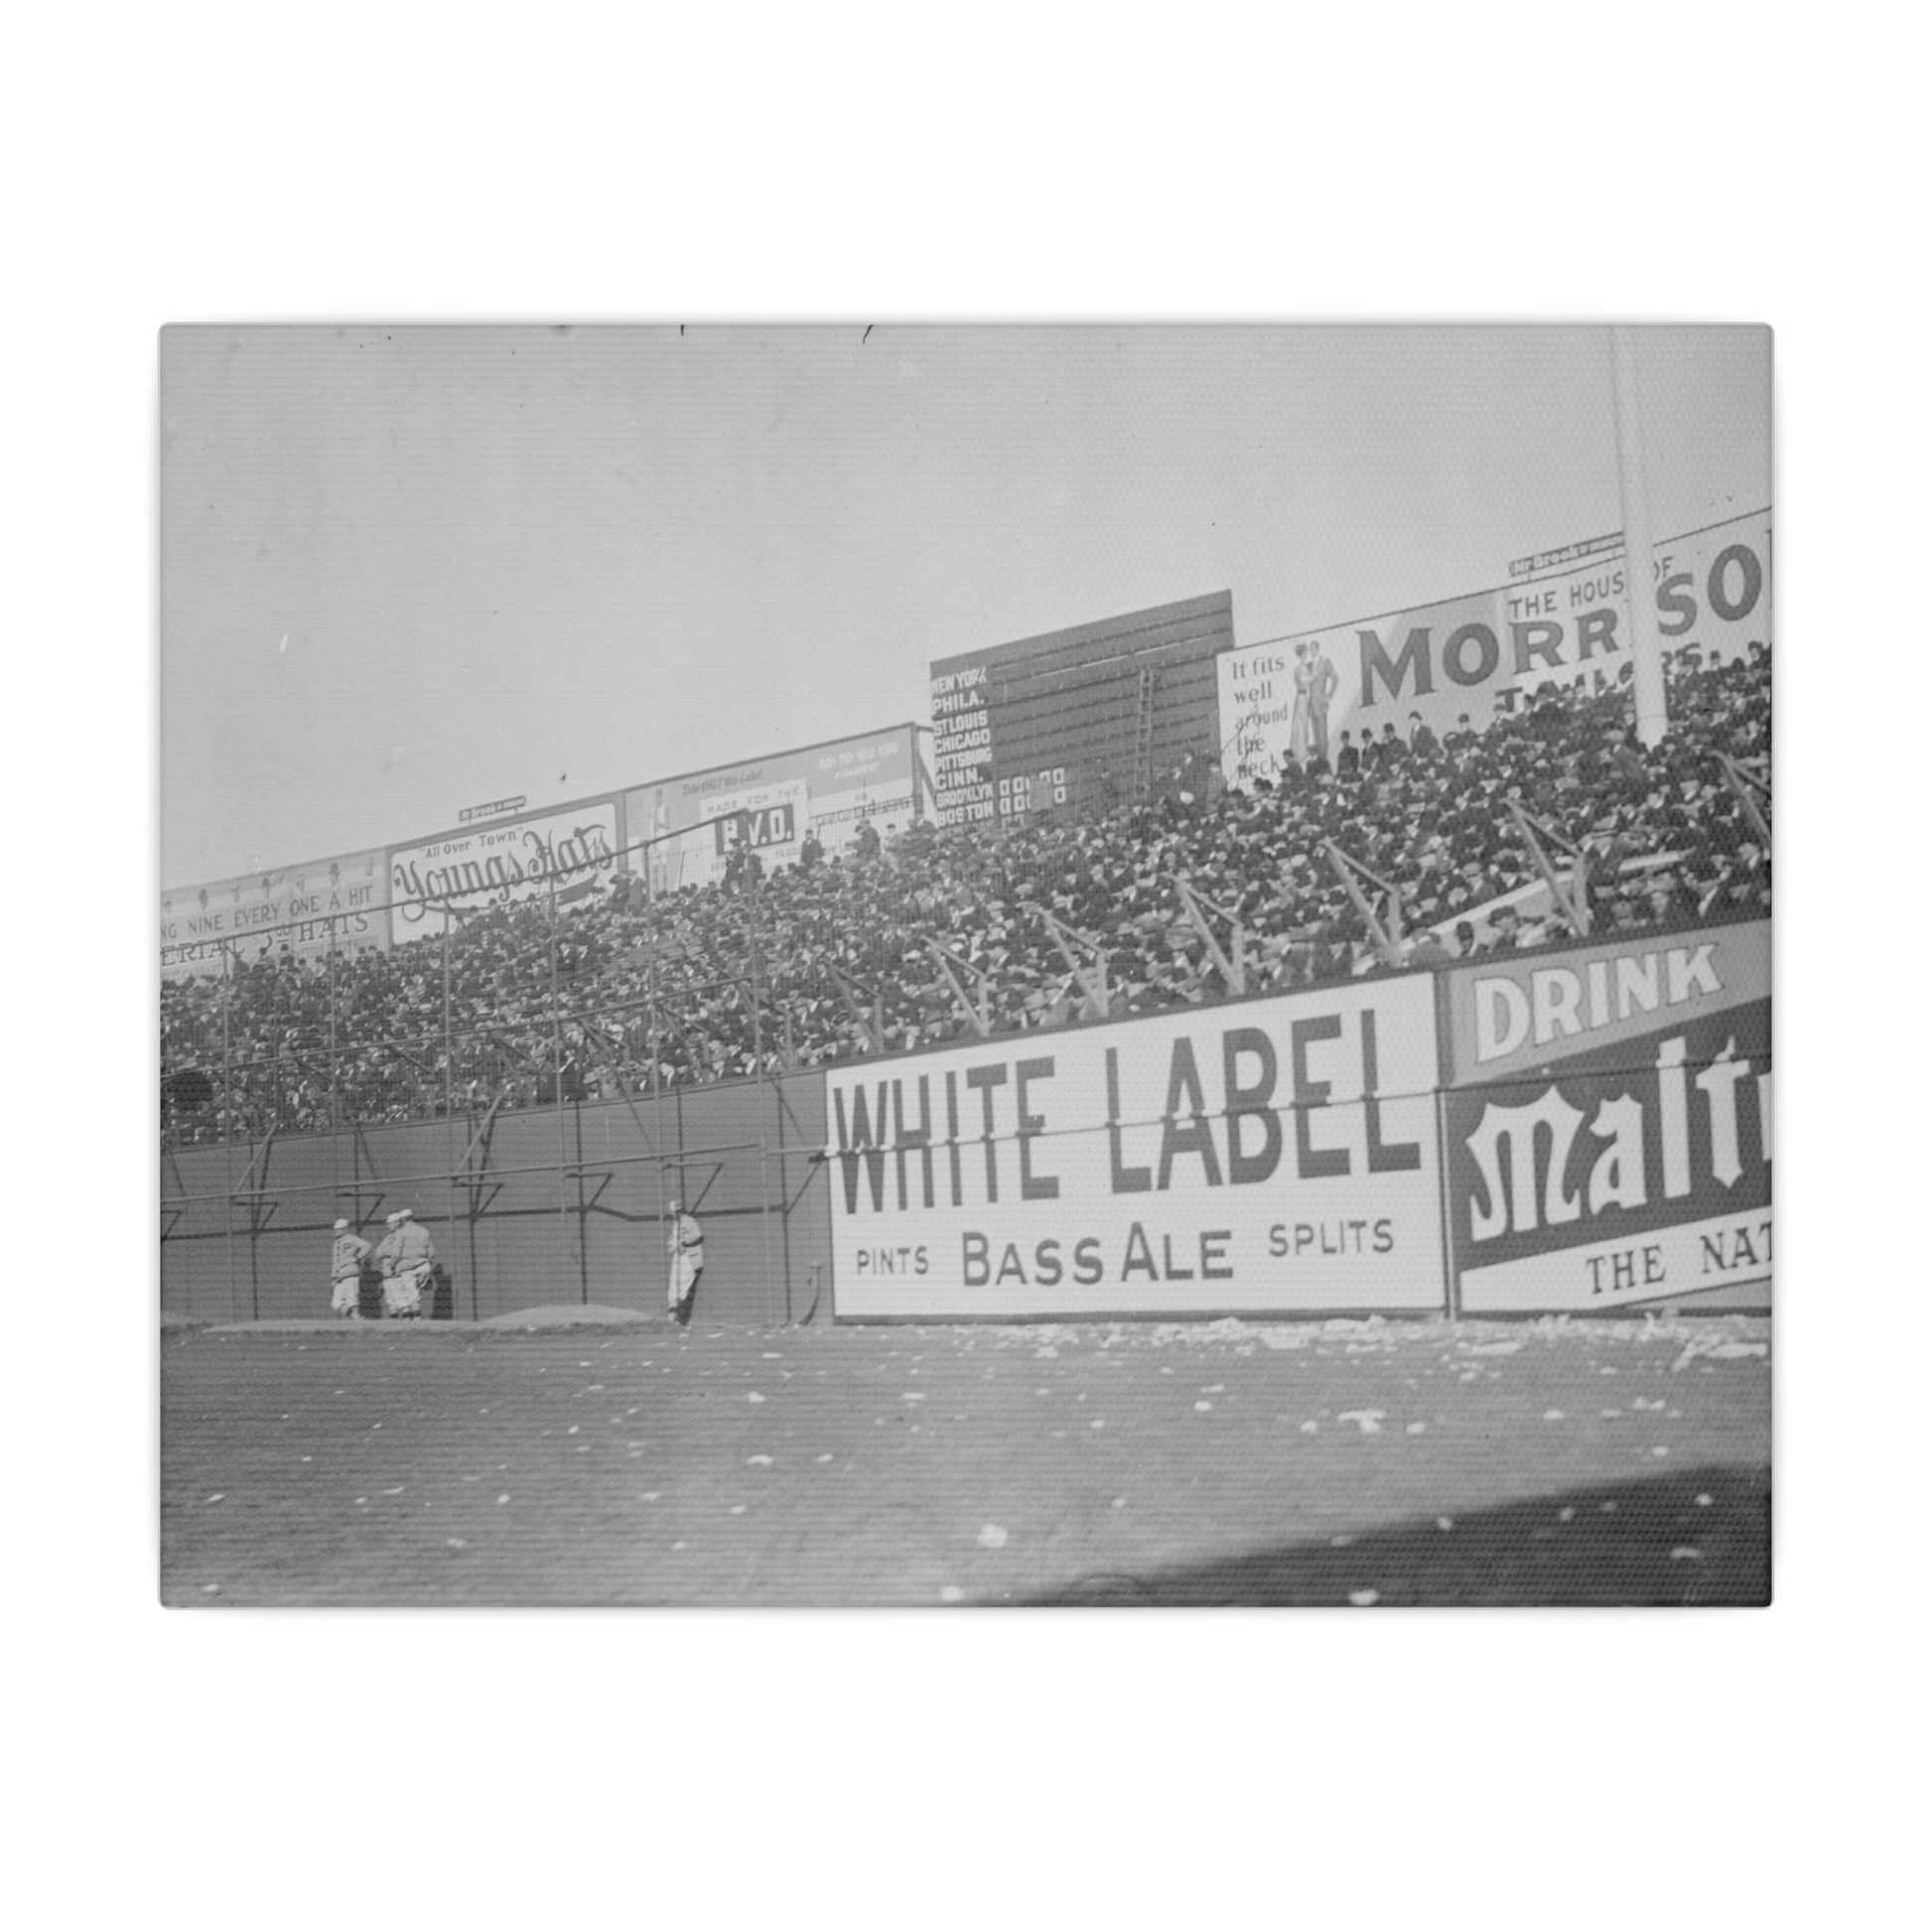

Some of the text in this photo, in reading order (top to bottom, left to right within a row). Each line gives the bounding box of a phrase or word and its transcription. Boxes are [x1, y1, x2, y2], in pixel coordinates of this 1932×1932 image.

[1508, 591, 1558, 620] THE
[1571, 571, 1624, 608] HOUS
[1253, 657, 1285, 676] fits
[931, 689, 986, 716] PHILA.
[1234, 680, 1272, 704] well
[1235, 703, 1289, 730] around
[934, 728, 992, 755] CHICAGO
[1237, 736, 1266, 756] the
[935, 746, 993, 773] PITTSBURG
[936, 766, 984, 790] CINN.
[936, 782, 994, 808] BROOKLYN
[937, 800, 994, 827] BOSTON
[444, 840, 473, 855] Over
[189, 912, 223, 935] NINE
[234, 901, 282, 928] EVERY
[290, 896, 321, 917] ONE
[330, 891, 342, 910] A
[348, 885, 373, 906] HIT
[298, 912, 369, 943] HATS
[1473, 942, 1725, 1063] DRINK
[833, 1007, 1422, 1214] WHITE LABEL
[857, 1244, 929, 1277] PINTS
[1268, 1217, 1395, 1259] SPLITS
[1587, 1244, 1667, 1295] THE
